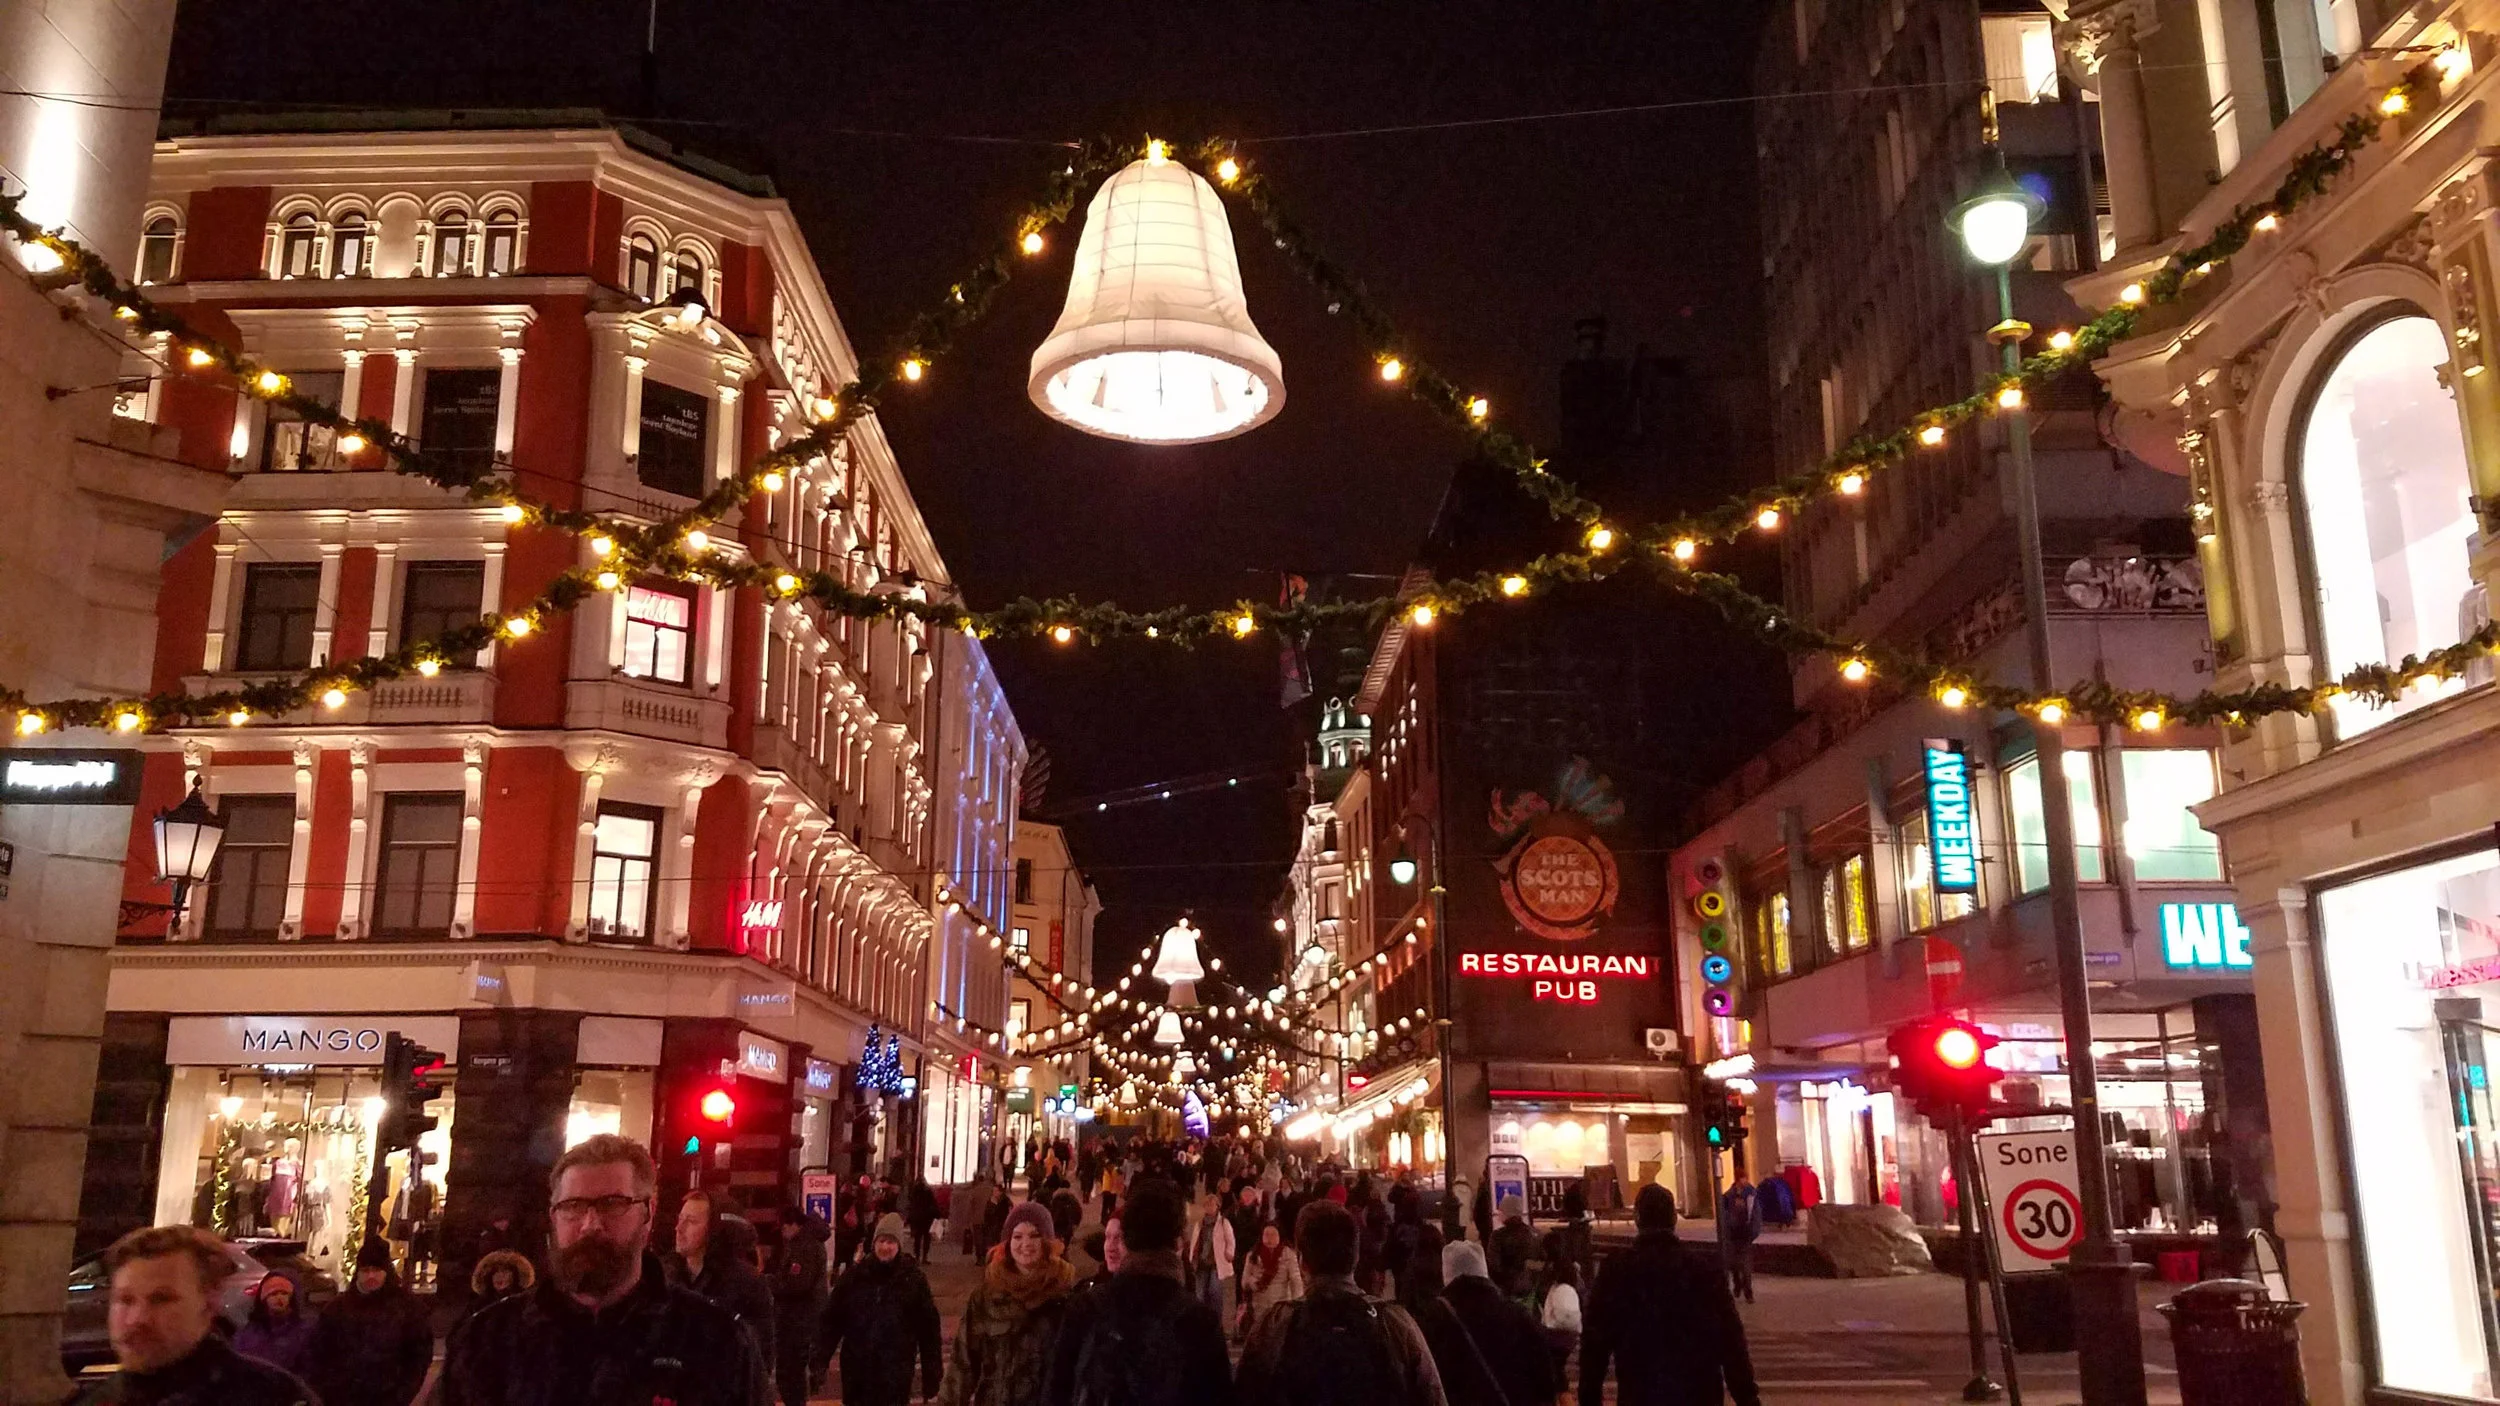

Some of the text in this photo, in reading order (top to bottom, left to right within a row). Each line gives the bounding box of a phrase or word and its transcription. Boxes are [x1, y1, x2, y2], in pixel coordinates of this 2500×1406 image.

[1928, 748, 1975, 884] WEEKDAY
[1541, 853, 1580, 866] THE
[1520, 868, 1598, 887] SCOTS
[1540, 889, 1585, 903] MAN
[739, 994, 791, 1005] MANGO
[1534, 980, 1597, 1000] PUB
[242, 1029, 382, 1052] MANGO
[1997, 1141, 2068, 1166] Sone
[2018, 1199, 2071, 1239] 30
